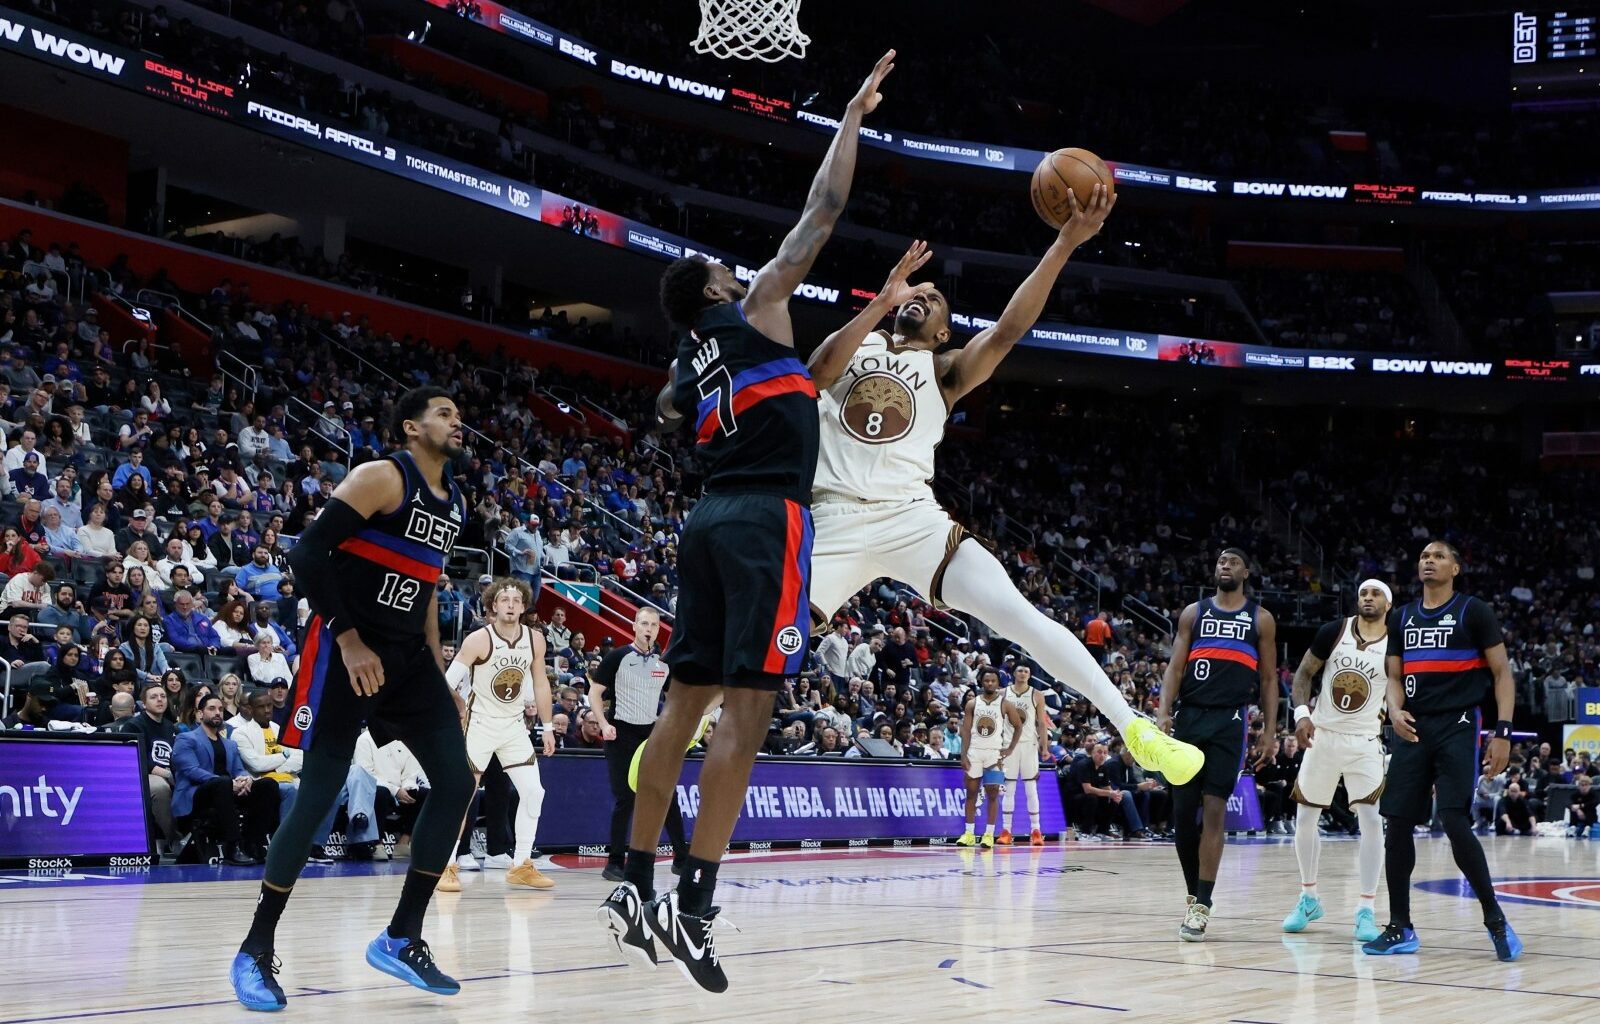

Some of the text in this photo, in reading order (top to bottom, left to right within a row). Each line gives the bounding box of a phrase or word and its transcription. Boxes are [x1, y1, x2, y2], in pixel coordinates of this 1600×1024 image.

[1514, 12, 1536, 63] DET
[31, 28, 125, 75] WOW
[559, 37, 597, 65] B2K
[145, 60, 183, 80] BOYS
[198, 77, 234, 98] LIFE
[611, 60, 725, 101] BOW WOW
[171, 81, 208, 101] TOUR
[749, 101, 773, 113] TOUR
[247, 100, 322, 140] FRIDAY,
[325, 127, 381, 157] APRIL
[384, 146, 396, 161] 3
[797, 110, 842, 129] FRIDAY
[859, 126, 882, 140] RIL
[903, 138, 979, 158] TICKETMASTER.COM
[405, 155, 500, 196] TICKETMASTER.COM
[1176, 176, 1217, 193] B2K
[1233, 182, 1347, 198] BOW WOW
[1540, 193, 1600, 203] TICKETMASTER
[1032, 329, 1119, 347] TICKETMASTER.COM
[691, 337, 720, 376] REED
[1308, 356, 1355, 370] B2K
[1372, 358, 1492, 376] BOW WOW
[845, 356, 927, 391] TOWN
[697, 364, 738, 437] 7
[866, 412, 883, 436] 8
[404, 507, 460, 553] DET
[377, 573, 420, 611] 12
[782, 633, 798, 647] DET
[1200, 618, 1251, 641] DET
[1404, 627, 1453, 650] DET
[491, 655, 530, 670] TOWN
[1194, 658, 1211, 680] 8
[1333, 656, 1379, 680] TOWN
[504, 687, 513, 700] 2
[1405, 674, 1416, 698] 9
[1340, 694, 1351, 709] 0
[981, 728, 989, 737] 18
[0, 775, 84, 826] nity
[745, 786, 782, 818] THE
[781, 786, 832, 818] NBA.
[834, 787, 868, 817] ALL
[866, 787, 888, 817] IN
[888, 787, 926, 818] ONE
[923, 788, 981, 817] PLAC.
[893, 838, 912, 846] StockX
[28, 858, 73, 868] StockX
[109, 856, 152, 866] StockX
